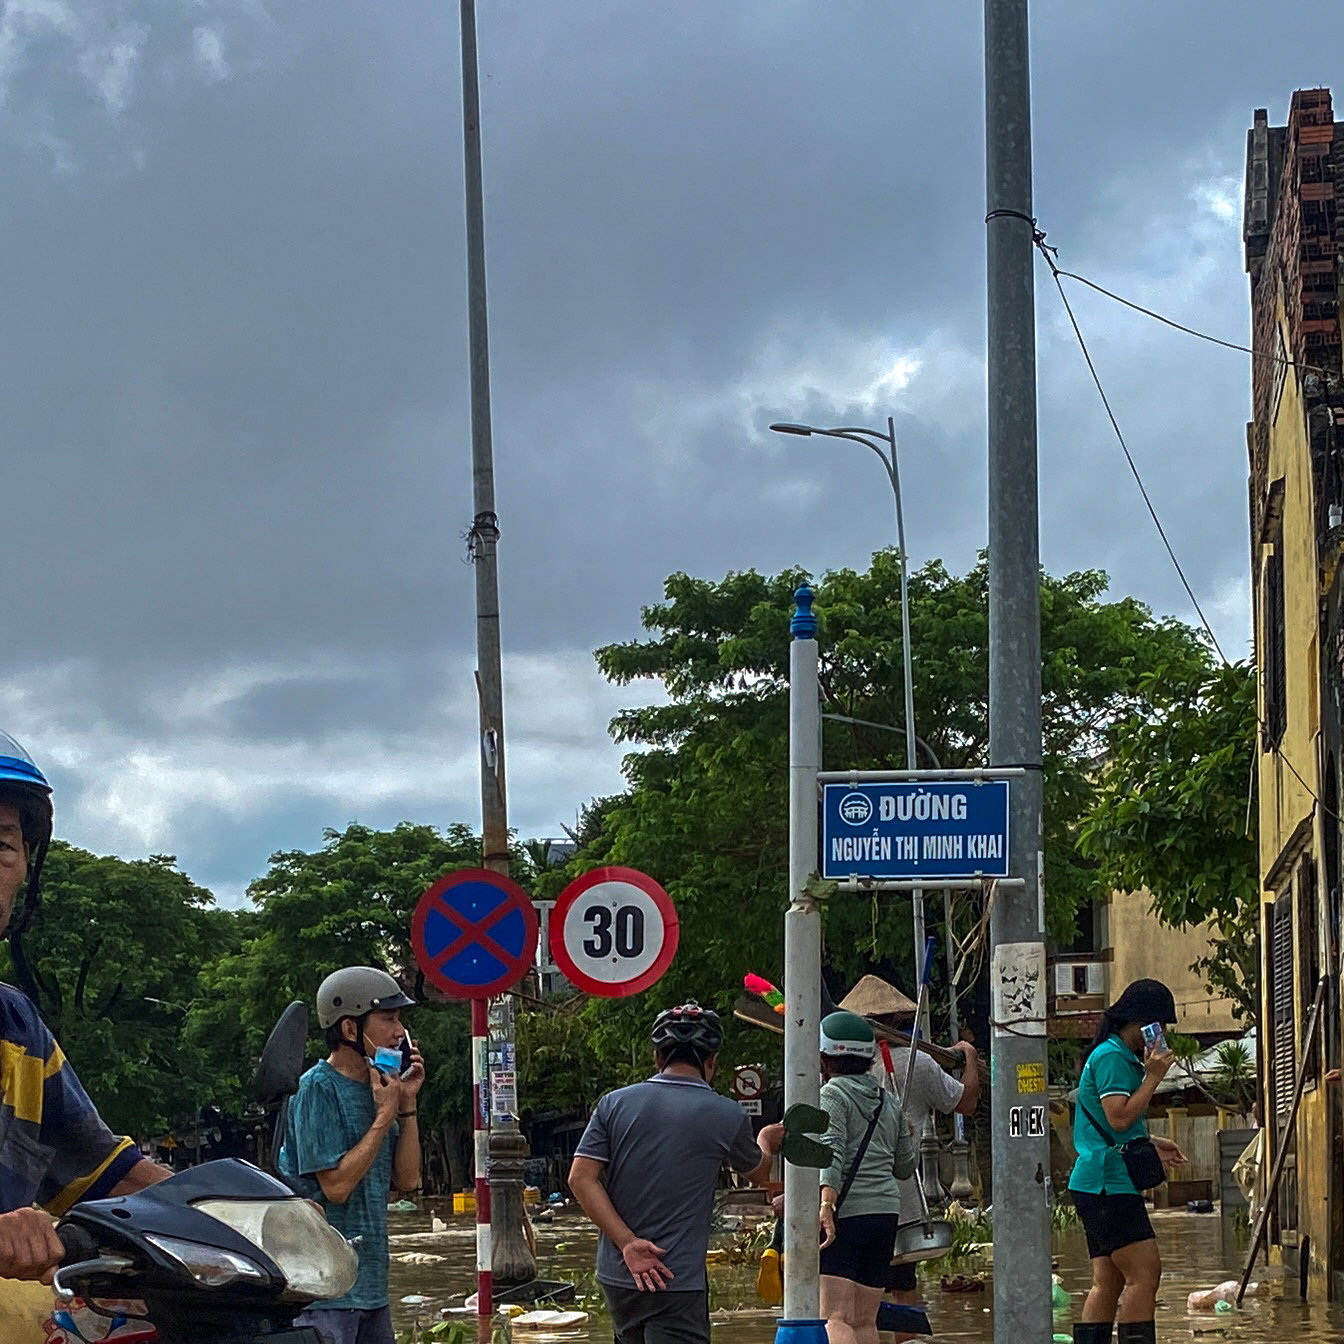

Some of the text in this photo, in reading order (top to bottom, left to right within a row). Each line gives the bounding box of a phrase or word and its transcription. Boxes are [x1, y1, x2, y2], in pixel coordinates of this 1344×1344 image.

[878, 788, 968, 822] ĐƯỜNG
[831, 827, 1004, 866] NGUYỄN THỊ MINH KHAI
[582, 905, 645, 959] 30
[1010, 1106, 1045, 1137] AEK
